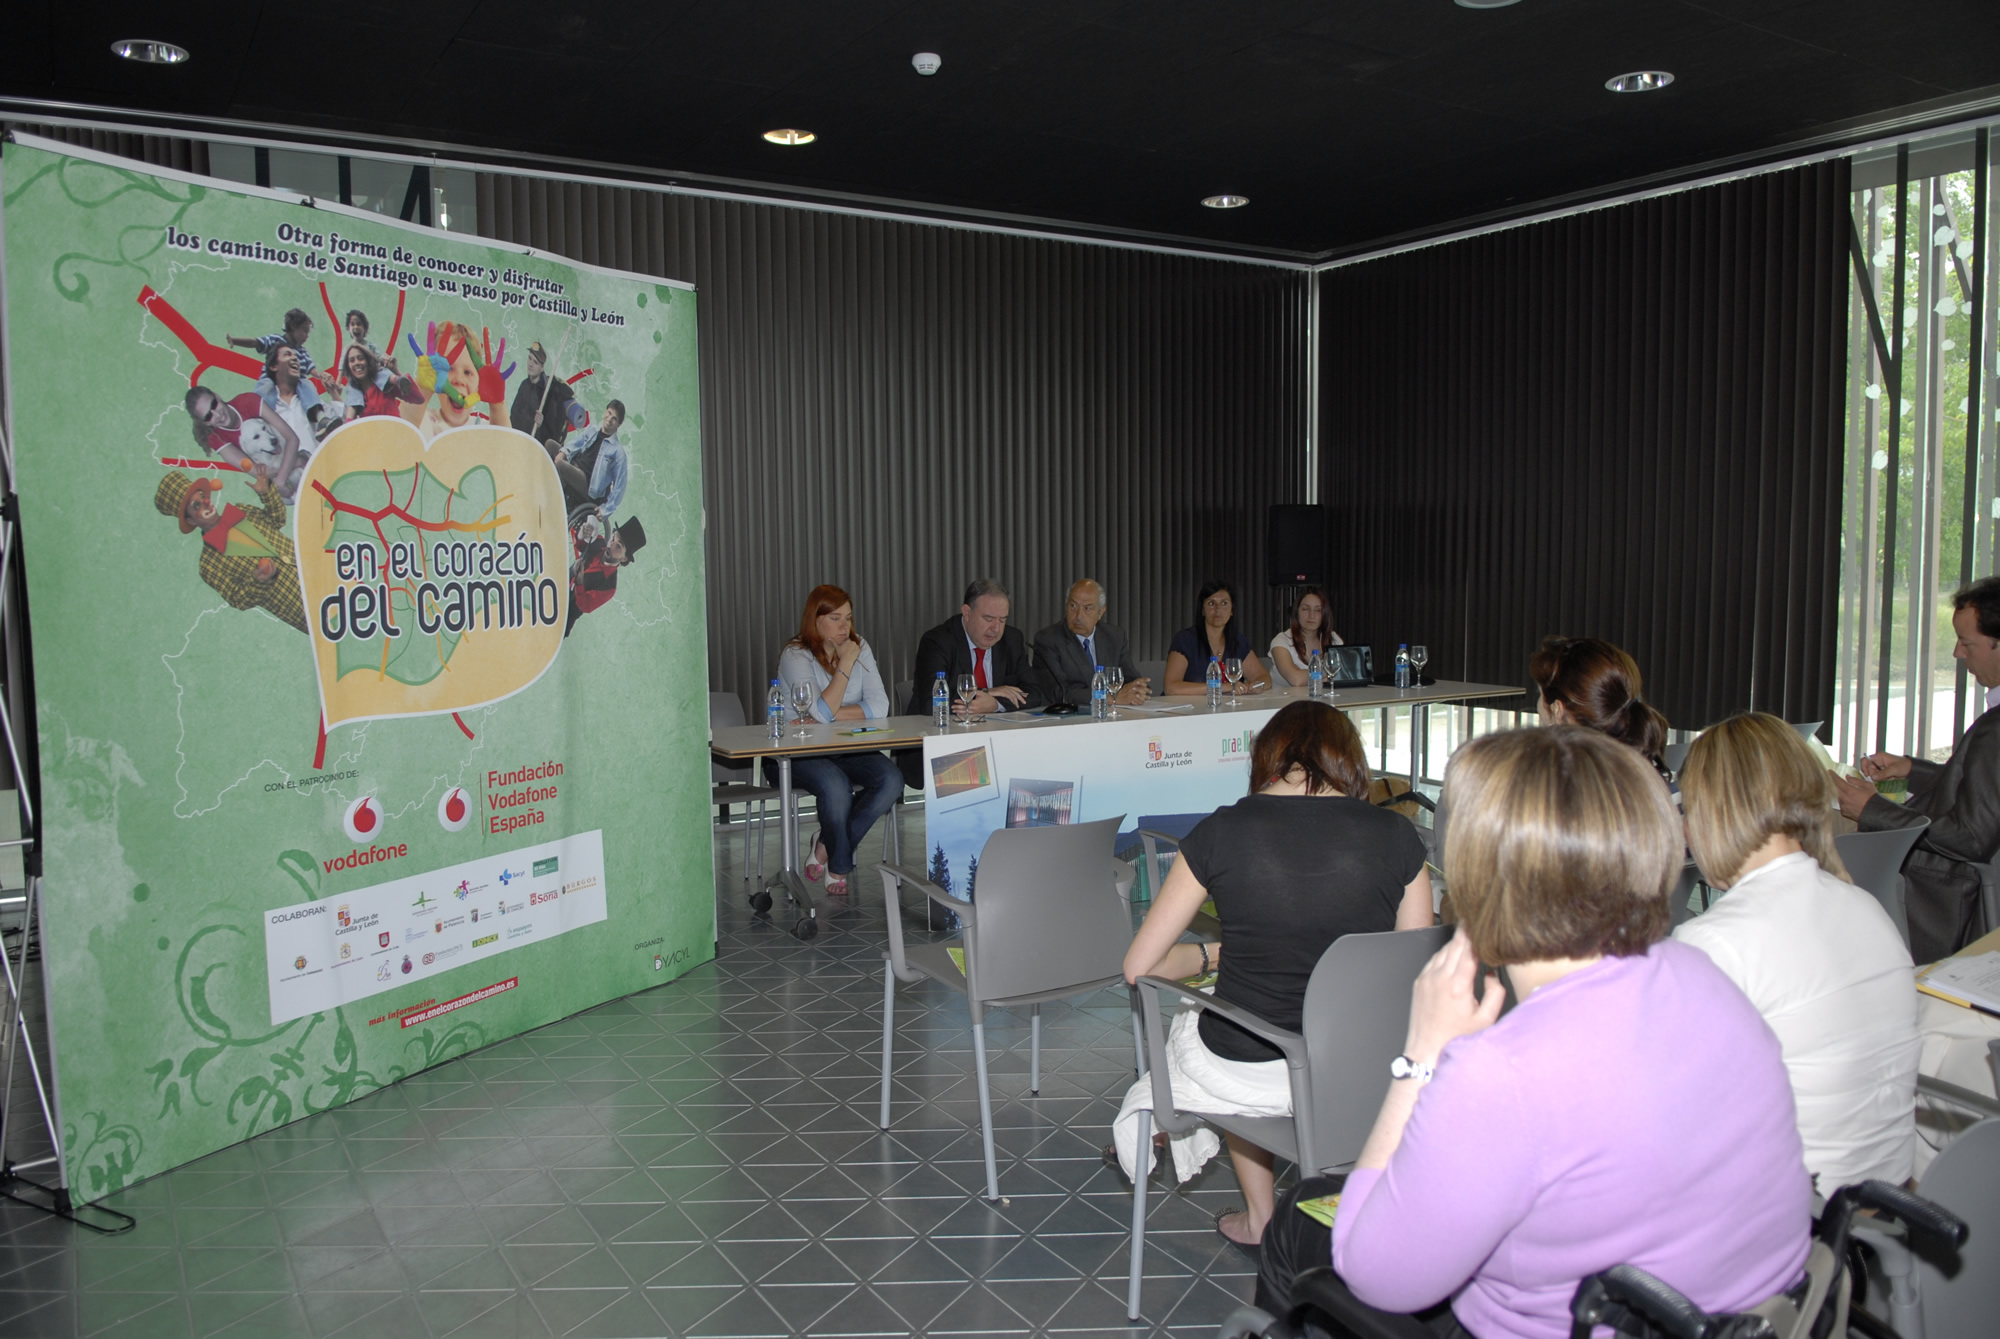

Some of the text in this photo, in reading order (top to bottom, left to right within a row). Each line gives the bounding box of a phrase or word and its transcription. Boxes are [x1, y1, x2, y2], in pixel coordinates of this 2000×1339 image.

[277, 223, 565, 295] Otra forma de conocer y disfrutar
[167, 226, 625, 326] los caminos de Santiago a su paso por Castilla y León
[336, 530, 544, 581] en el corazón
[320, 577, 559, 642] del camino
[1164, 752, 1183, 760] Junta
[1221, 737, 1242, 757] prae
[488, 761, 564, 789] Fundación
[1145, 760, 1169, 769] Castilla
[1176, 758, 1193, 766] León
[264, 769, 360, 793] CON EL PATROCINIO DE:
[488, 786, 558, 811] Vodafone
[490, 808, 545, 834] España
[323, 843, 408, 874] vodafone
[566, 876, 597, 890] BURGOS
[537, 891, 559, 904] Soria
[271, 905, 327, 924] COLABORAN:
[352, 916, 370, 925] Junta
[335, 925, 358, 936] Castilla
[364, 919, 379, 928] León
[368, 997, 436, 1027] más información
[404, 979, 515, 1027] www.enelcorazondelcamino.es
